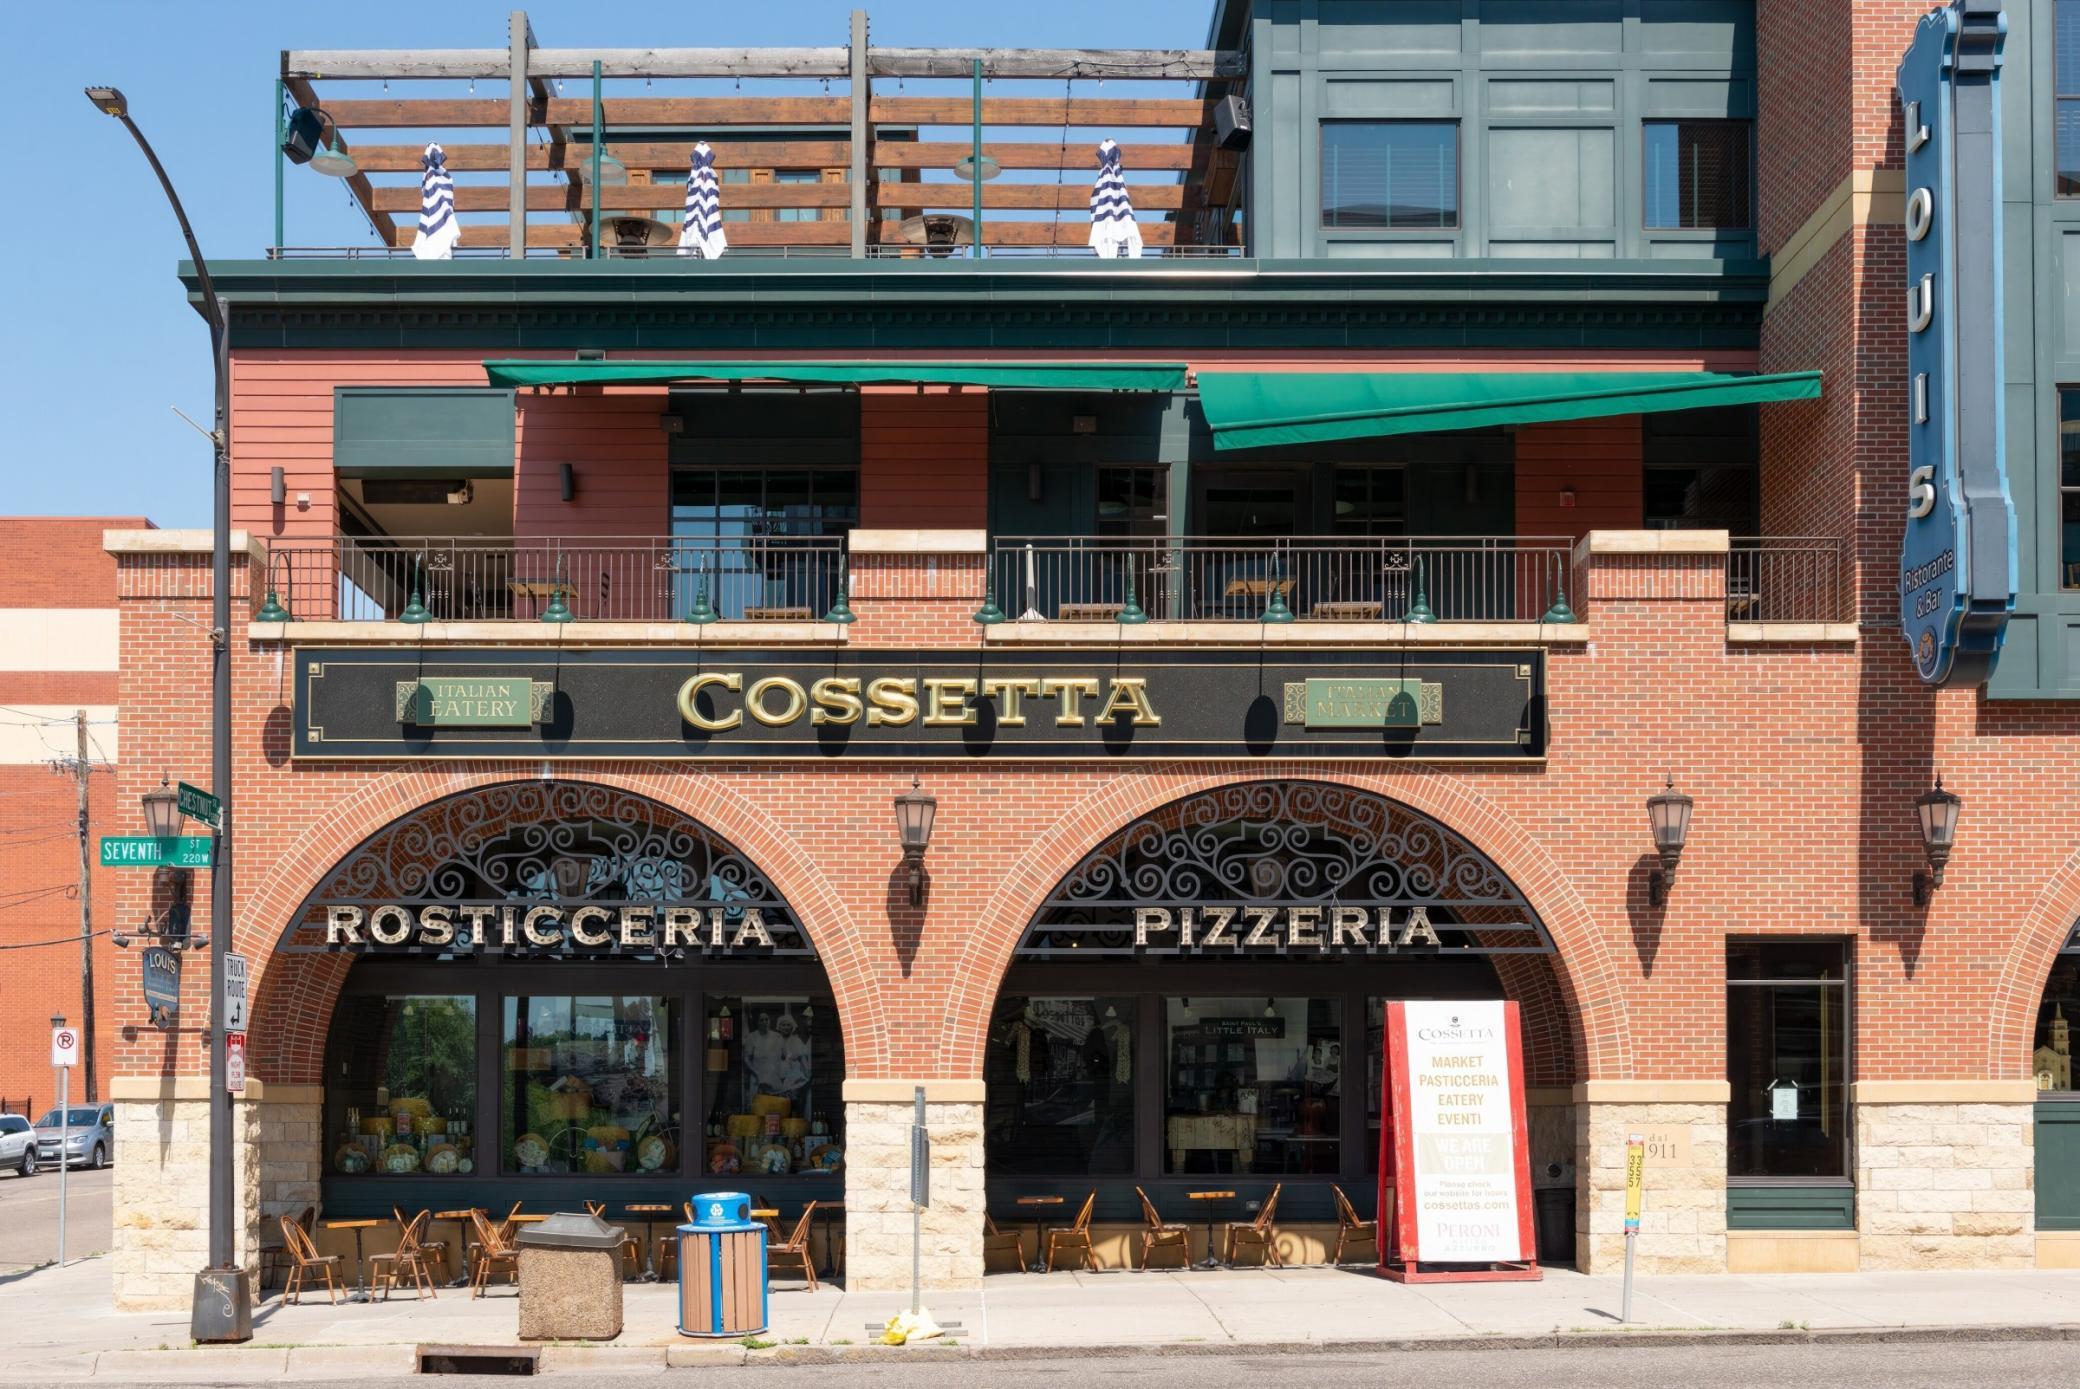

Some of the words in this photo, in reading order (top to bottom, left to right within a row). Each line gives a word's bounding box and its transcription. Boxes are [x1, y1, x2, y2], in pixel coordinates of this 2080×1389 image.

[1906, 101, 1937, 518] LOUIS
[1905, 550, 1954, 594] Ristorante
[1916, 597, 1924, 619] &
[1925, 588, 1942, 613] Bar
[438, 685, 511, 698] ITALIAN
[1328, 686, 1400, 699] ITALIAN
[430, 700, 518, 717] EATERY
[677, 672, 1161, 732] COSSETTA
[1317, 701, 1410, 718] MARKET
[179, 788, 212, 818] CHESTNUT
[104, 841, 162, 861] SEVENTH
[190, 839, 200, 849] ST
[326, 904, 776, 948] ROSTICCERIA
[1133, 906, 1442, 947] PIZZERIA
[149, 953, 176, 975] LOUIS
[227, 958, 245, 978] TRUCK
[227, 979, 245, 999] ROUTE
[1205, 1025, 1243, 1034] LITTLE
[1247, 1025, 1279, 1034] ITALY
[1432, 1055, 1484, 1068] MARKET
[1419, 1074, 1499, 1087] PASTICCERIA
[1438, 1094, 1484, 1106] EATERY
[1438, 1113, 1482, 1125] EVENTI
[1436, 1137, 1458, 1153] WE
[1462, 1137, 1492, 1153] ARE
[1444, 1155, 1486, 1170] OPEN
[1439, 1180, 1466, 1188] Please
[1424, 1200, 1510, 1210] cossettas.com
[1437, 1222, 1501, 1238] PERONI
